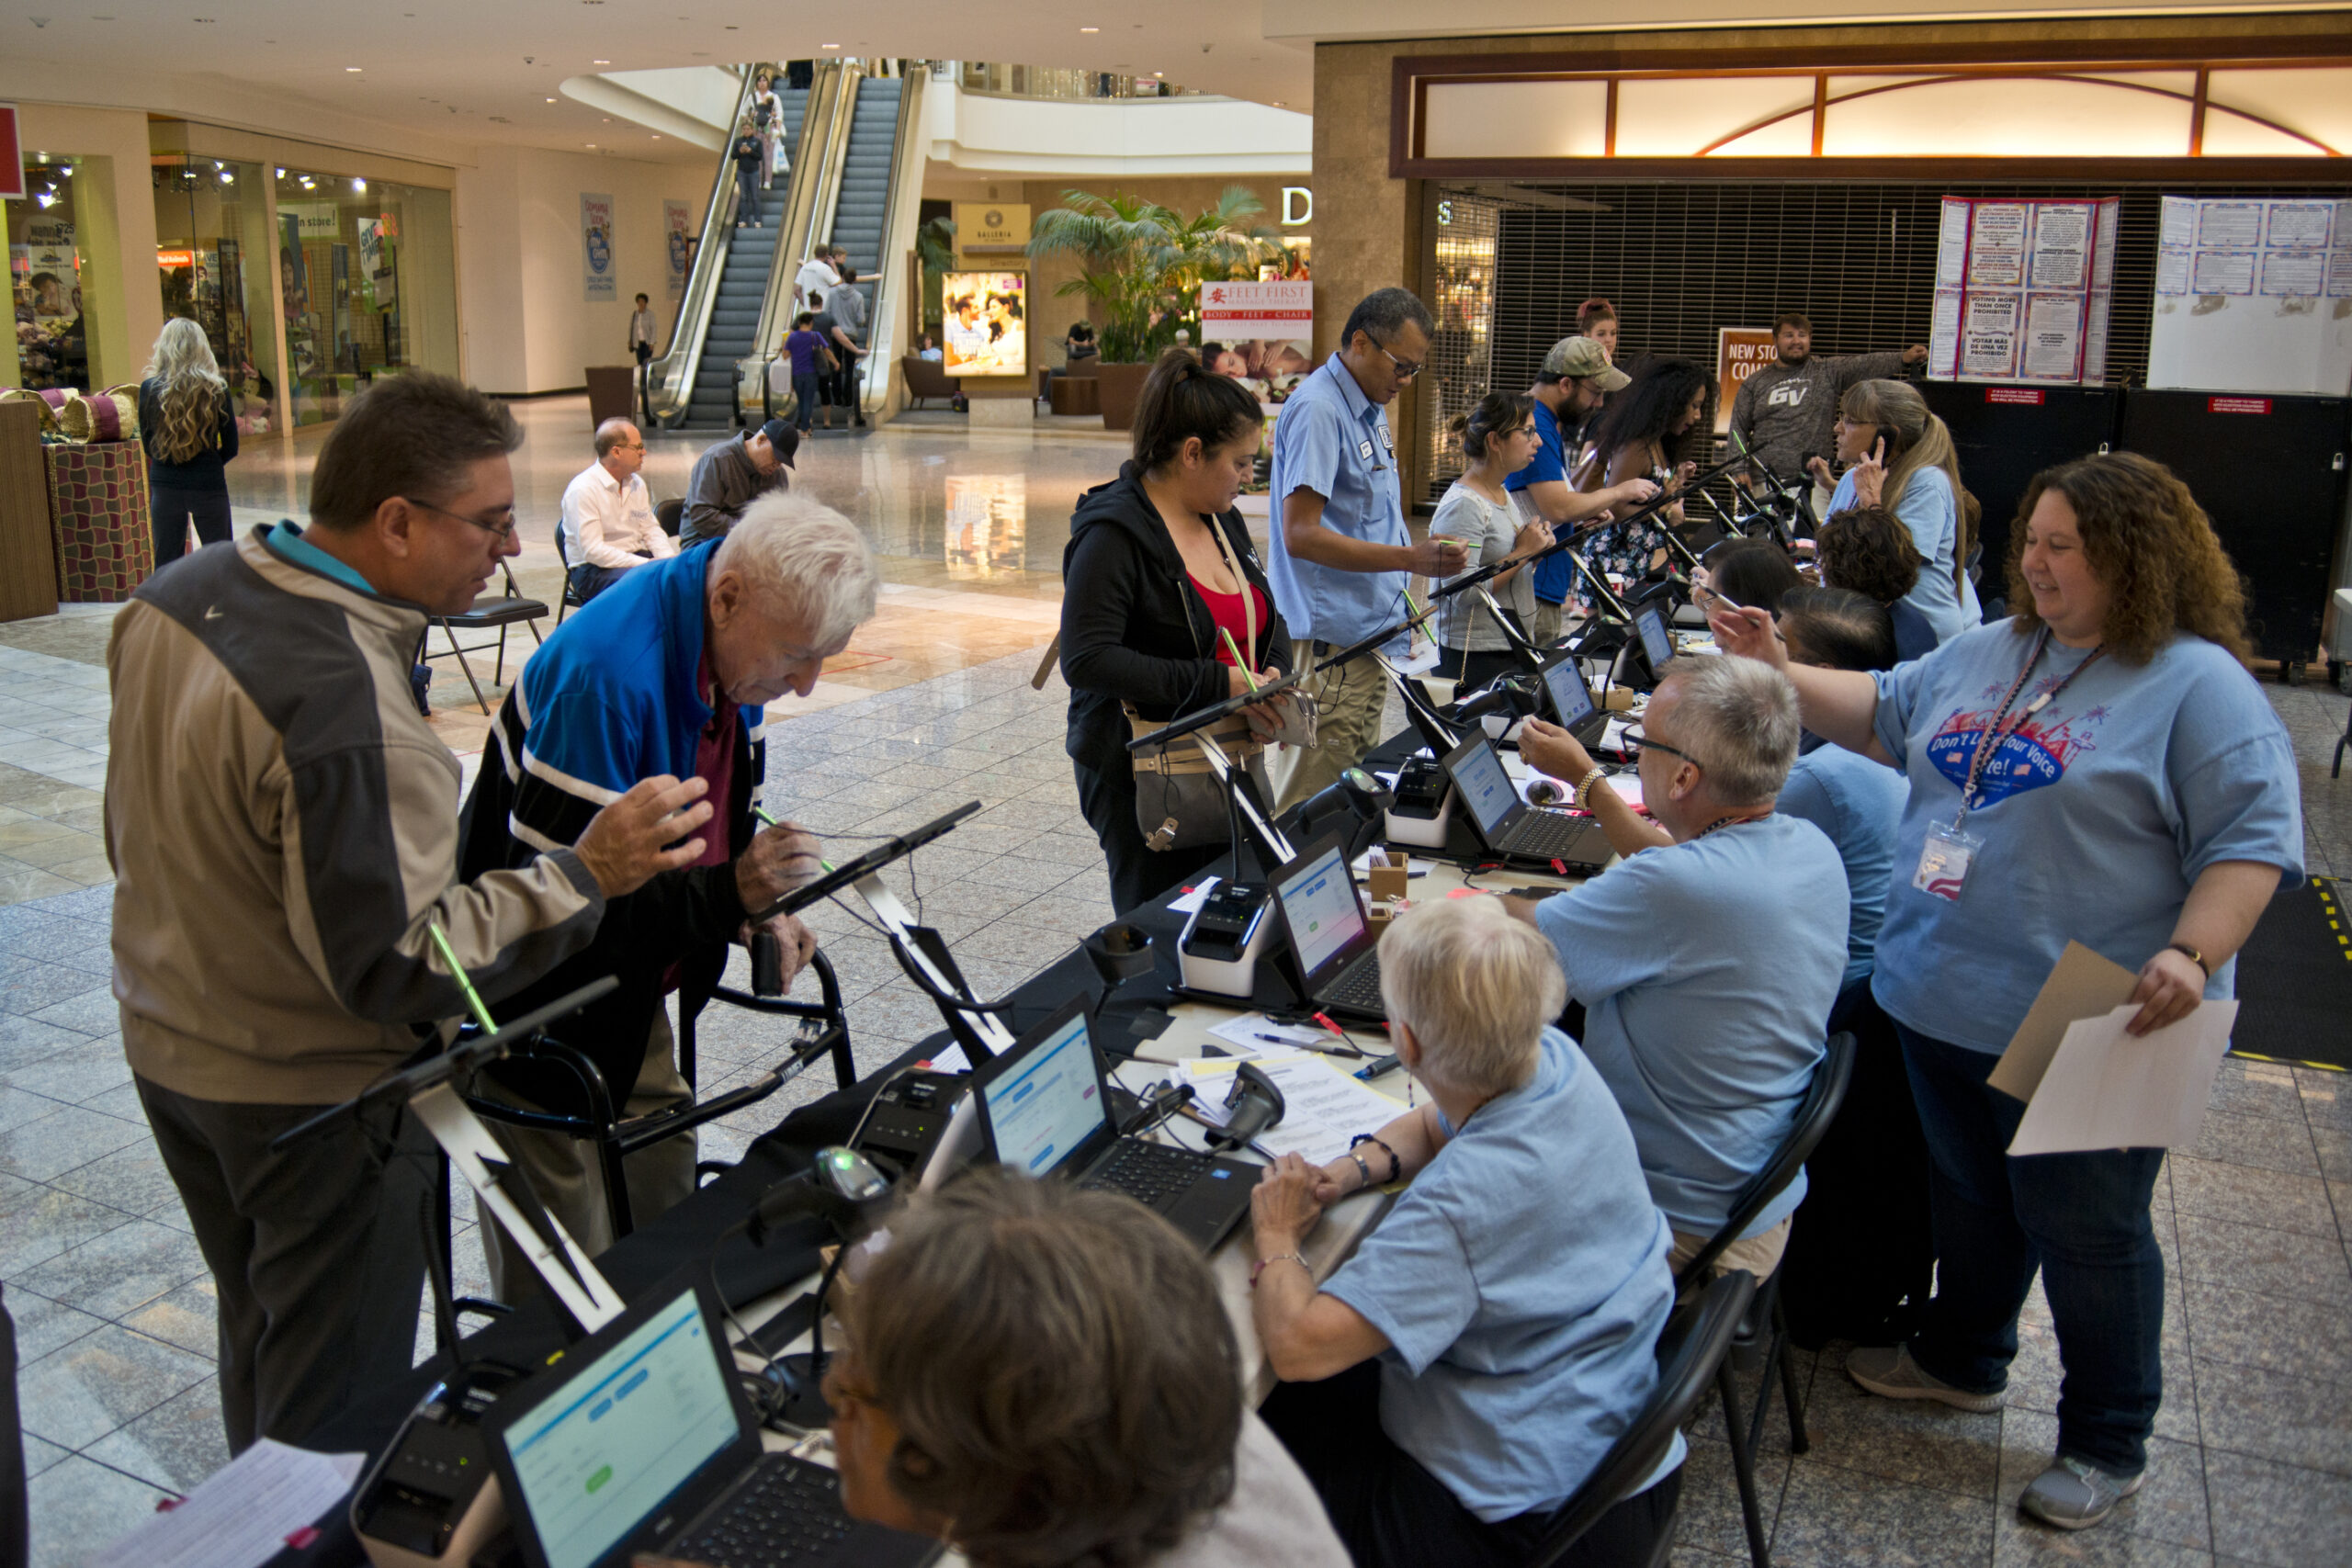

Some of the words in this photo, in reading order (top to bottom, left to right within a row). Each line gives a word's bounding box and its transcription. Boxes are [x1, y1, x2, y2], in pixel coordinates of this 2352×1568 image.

[1281, 186, 1312, 226] D
[308, 209, 335, 227] store!
[989, 257, 1026, 268] Directory
[1228, 286, 1261, 298] FEET
[1266, 286, 1306, 298] FIRST
[1729, 344, 1755, 359] NEW
[1769, 387, 1807, 406] GV
[1931, 732, 1969, 752] Don't
[2027, 745, 2055, 778] Voice
